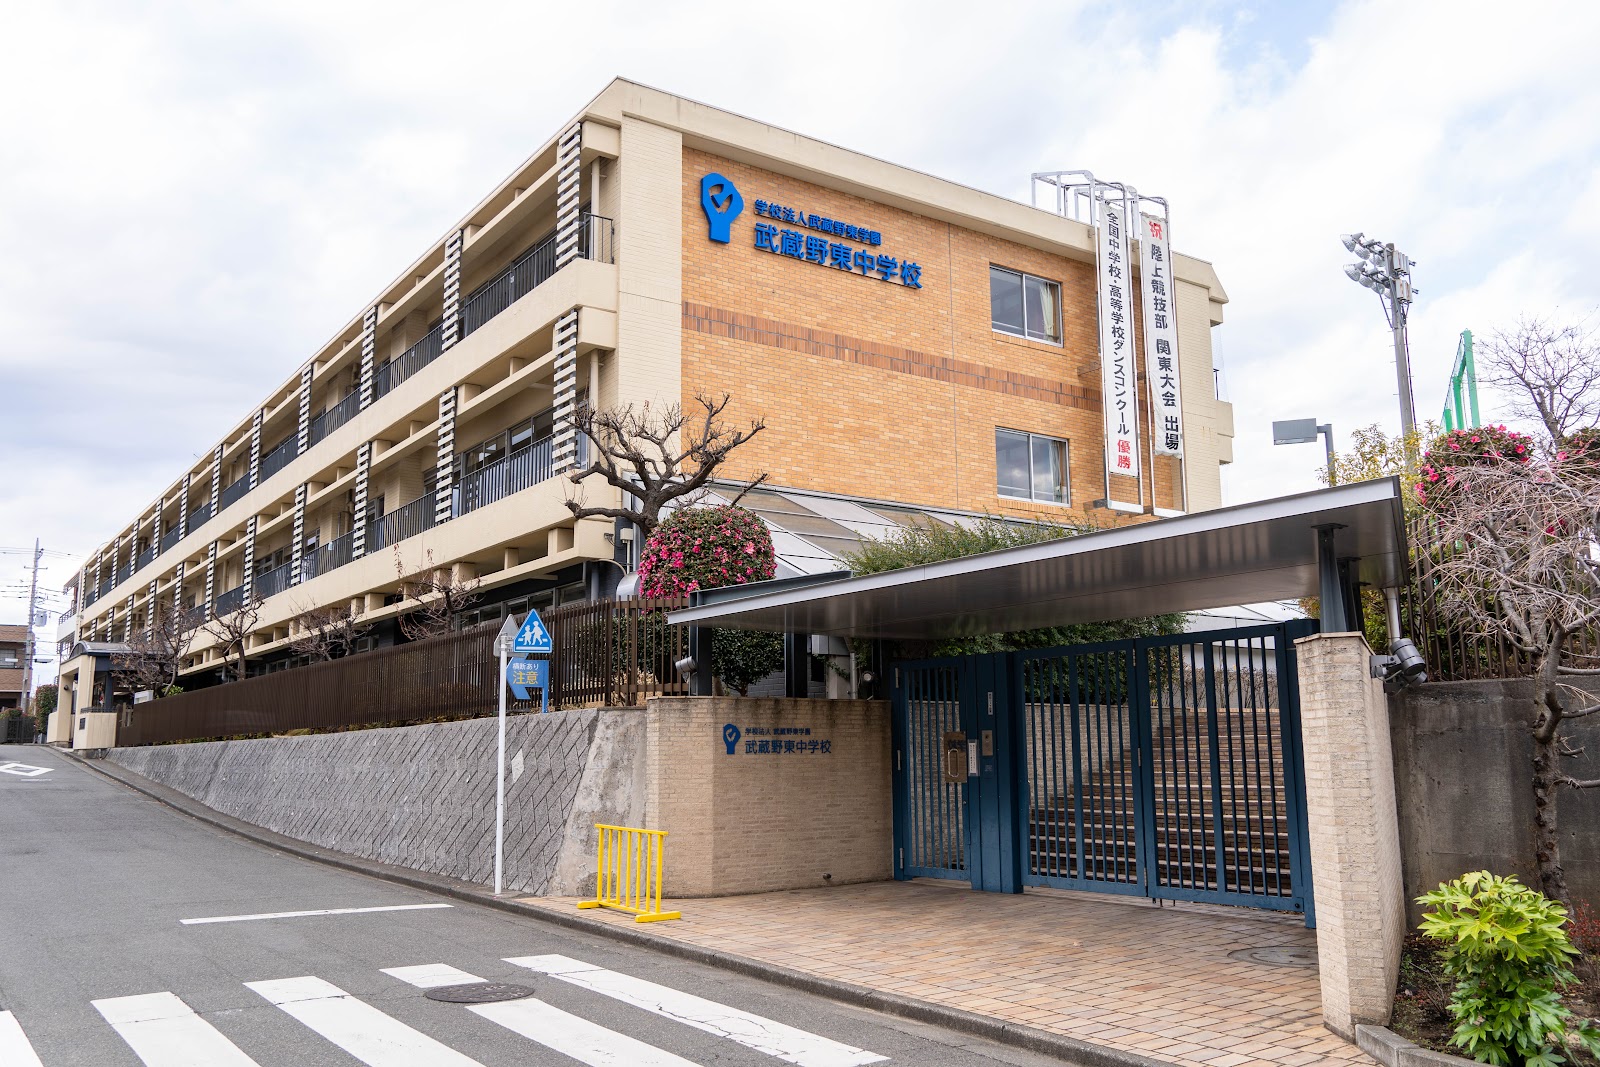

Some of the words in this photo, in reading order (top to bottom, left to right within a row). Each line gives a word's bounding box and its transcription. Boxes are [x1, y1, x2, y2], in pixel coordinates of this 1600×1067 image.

[754, 222, 923, 289] 武蔵野東中学校
[512, 662, 539, 671] 横断あり
[512, 670, 539, 685] 注意
[745, 739, 832, 755] 武蔵野東中学校
